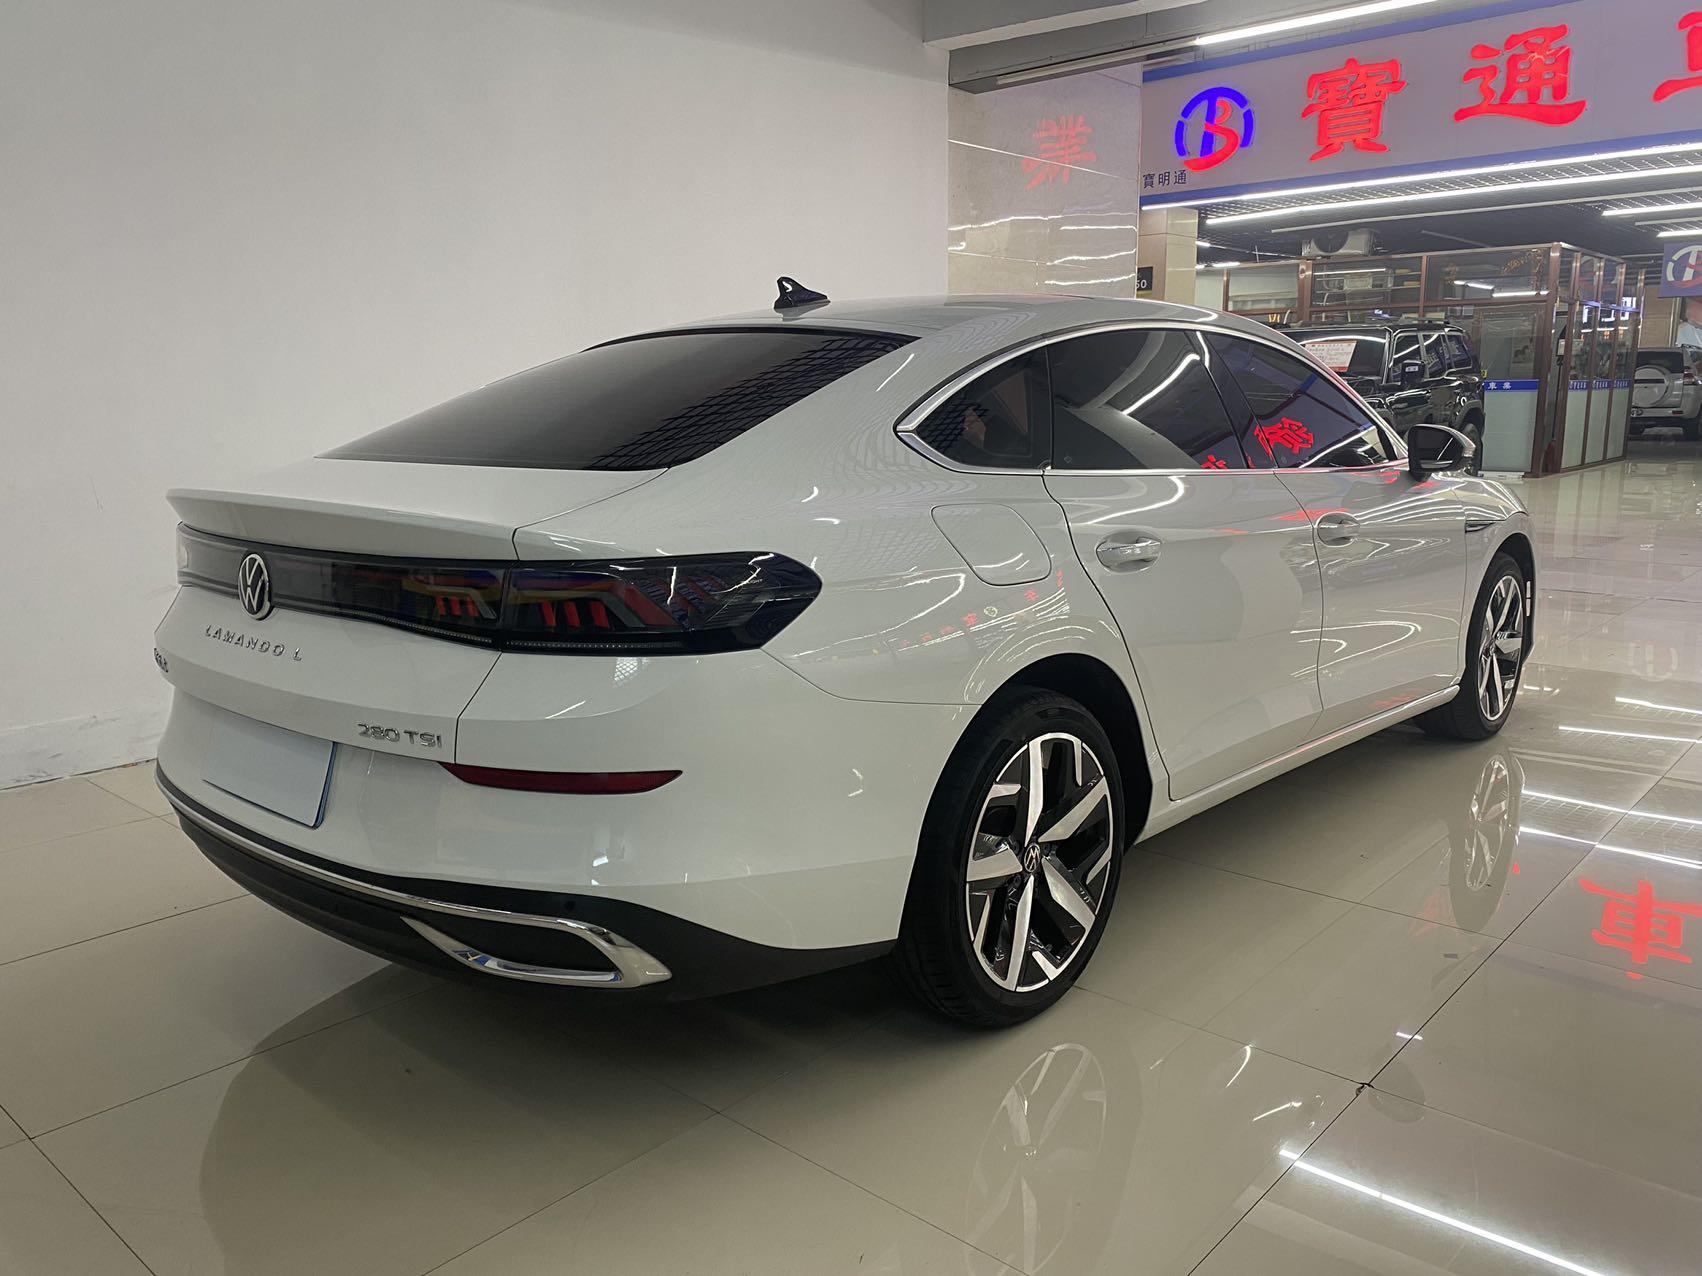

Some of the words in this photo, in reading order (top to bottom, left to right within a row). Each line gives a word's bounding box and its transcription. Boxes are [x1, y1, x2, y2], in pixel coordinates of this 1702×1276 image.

[205, 624, 285, 657] LAMANDO
[292, 648, 303, 662] L
[356, 723, 400, 742] 280
[403, 729, 443, 748] TSI
